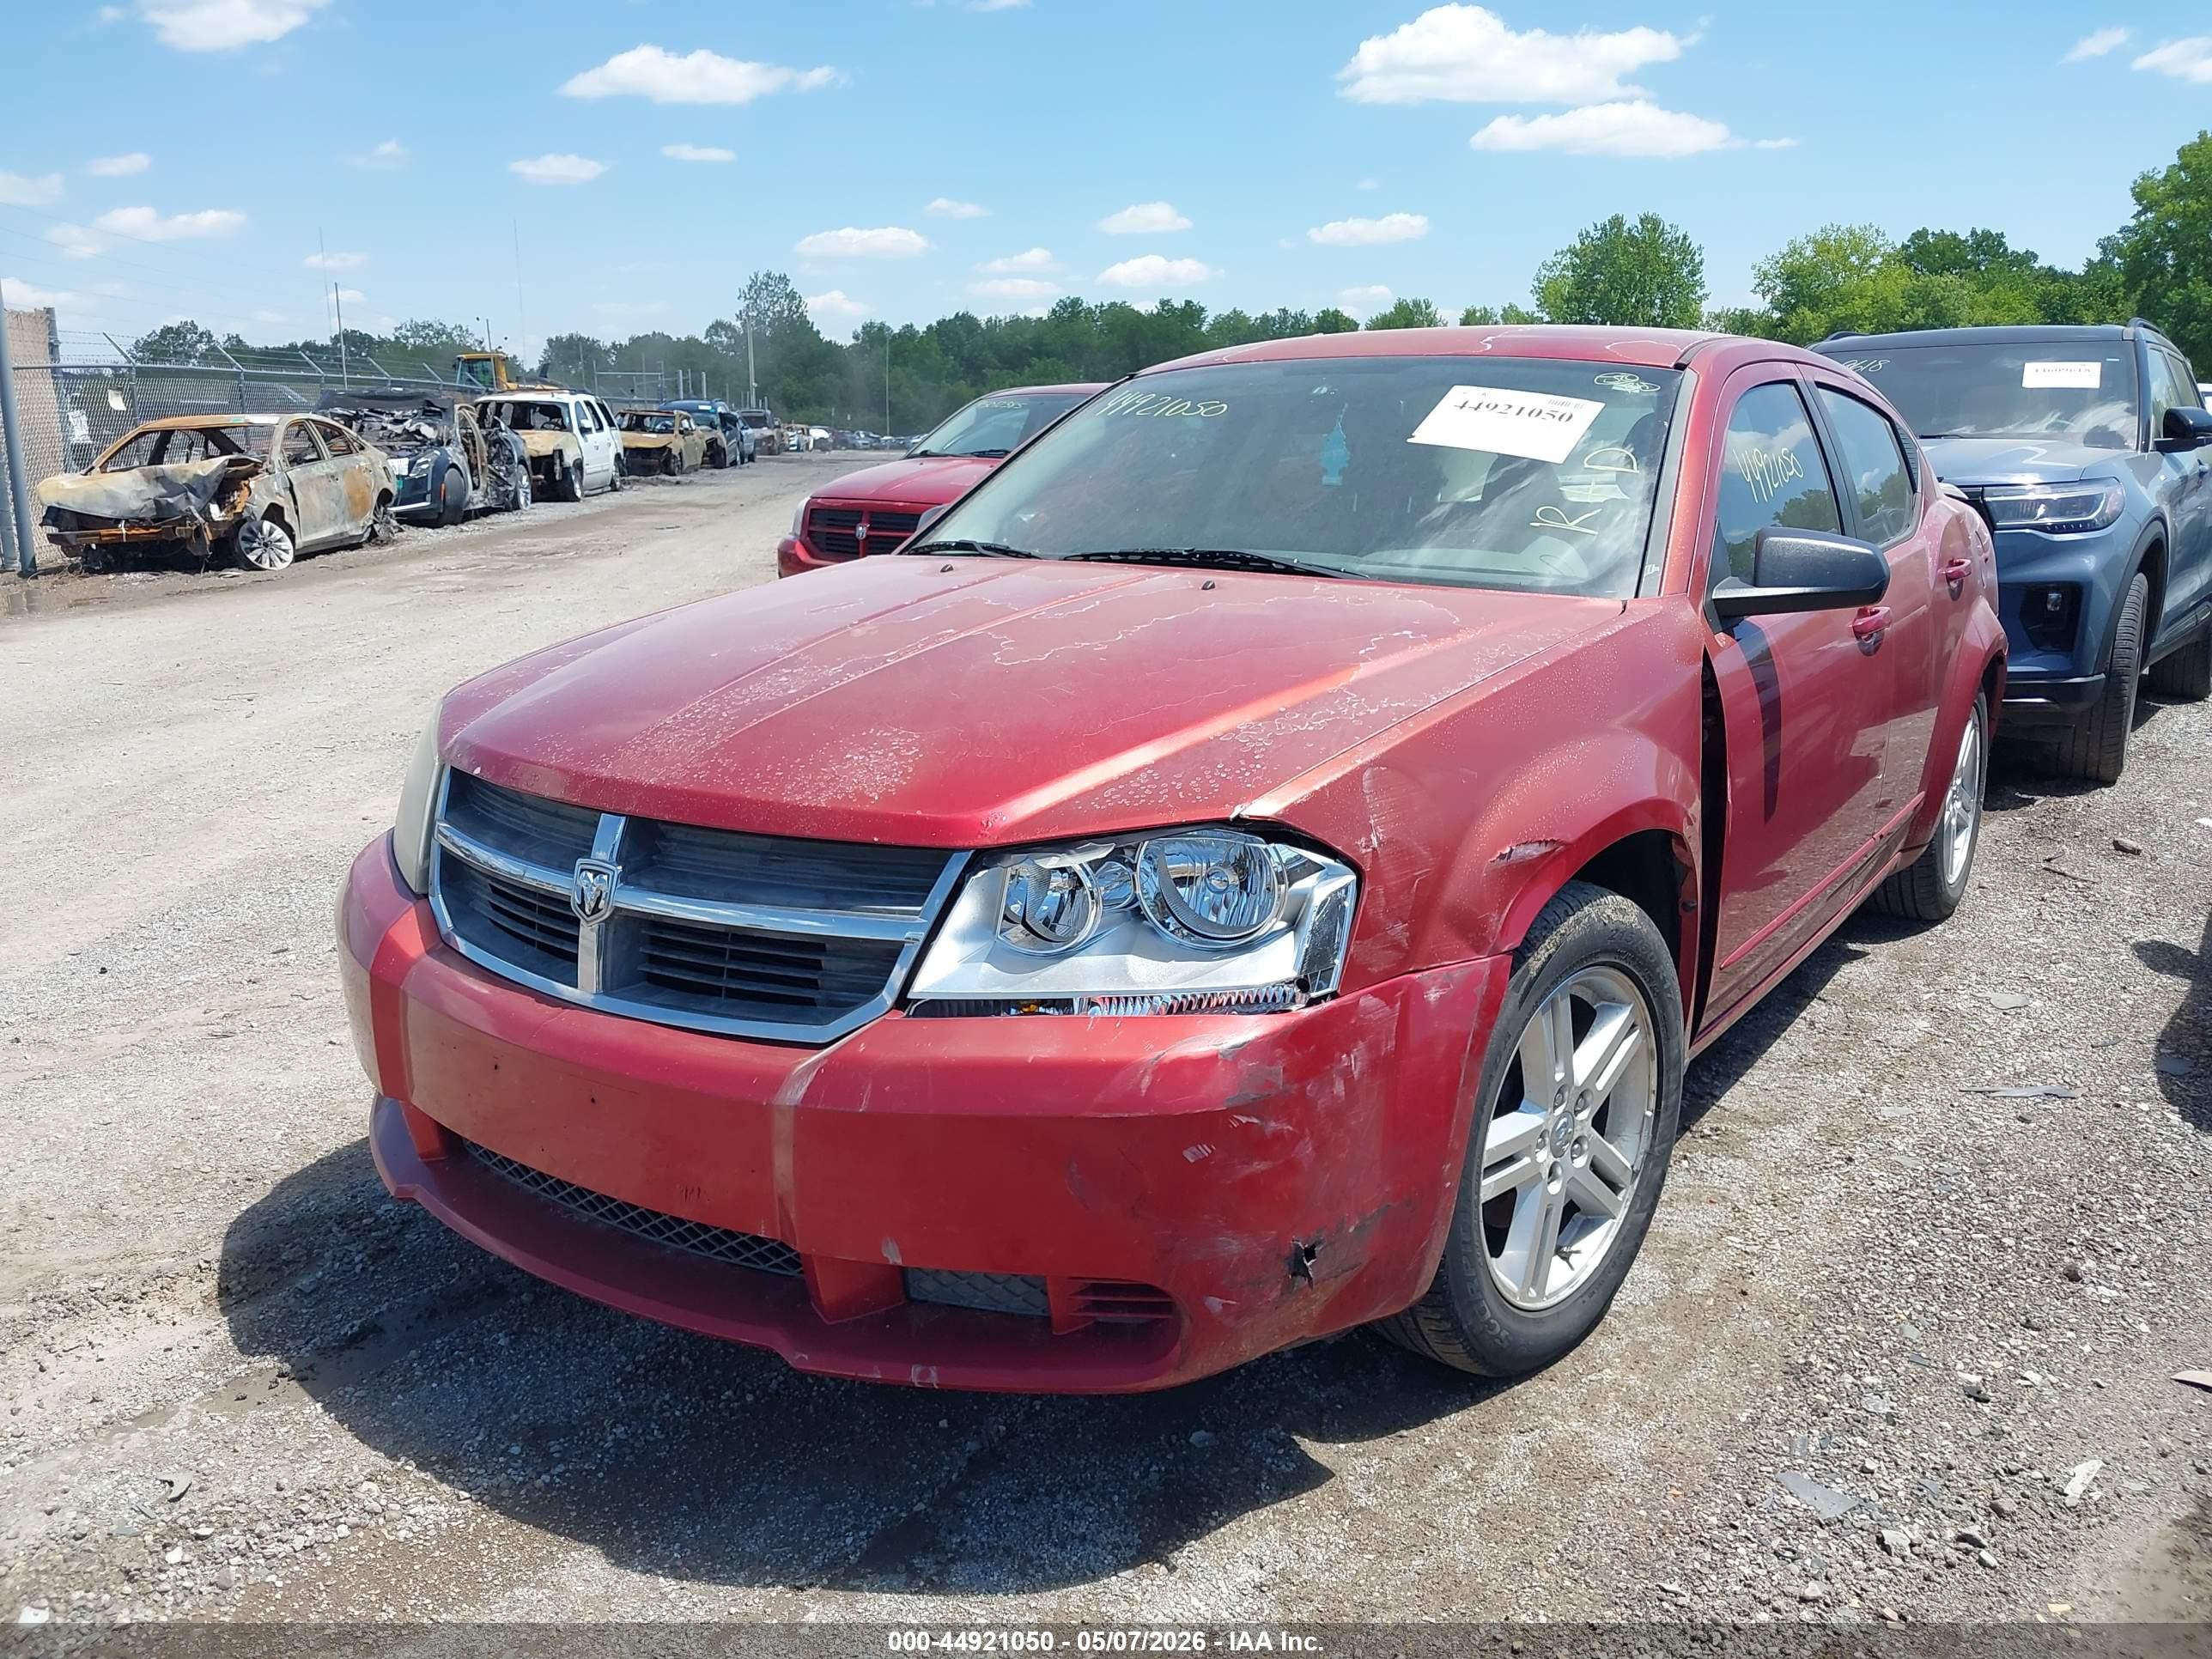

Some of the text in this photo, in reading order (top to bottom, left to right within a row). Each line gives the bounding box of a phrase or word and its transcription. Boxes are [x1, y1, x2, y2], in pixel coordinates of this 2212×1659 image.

[1096, 390, 1228, 417] 44921050
[1453, 399, 1575, 423] 44921050
[1732, 447, 1804, 504] 44921050
